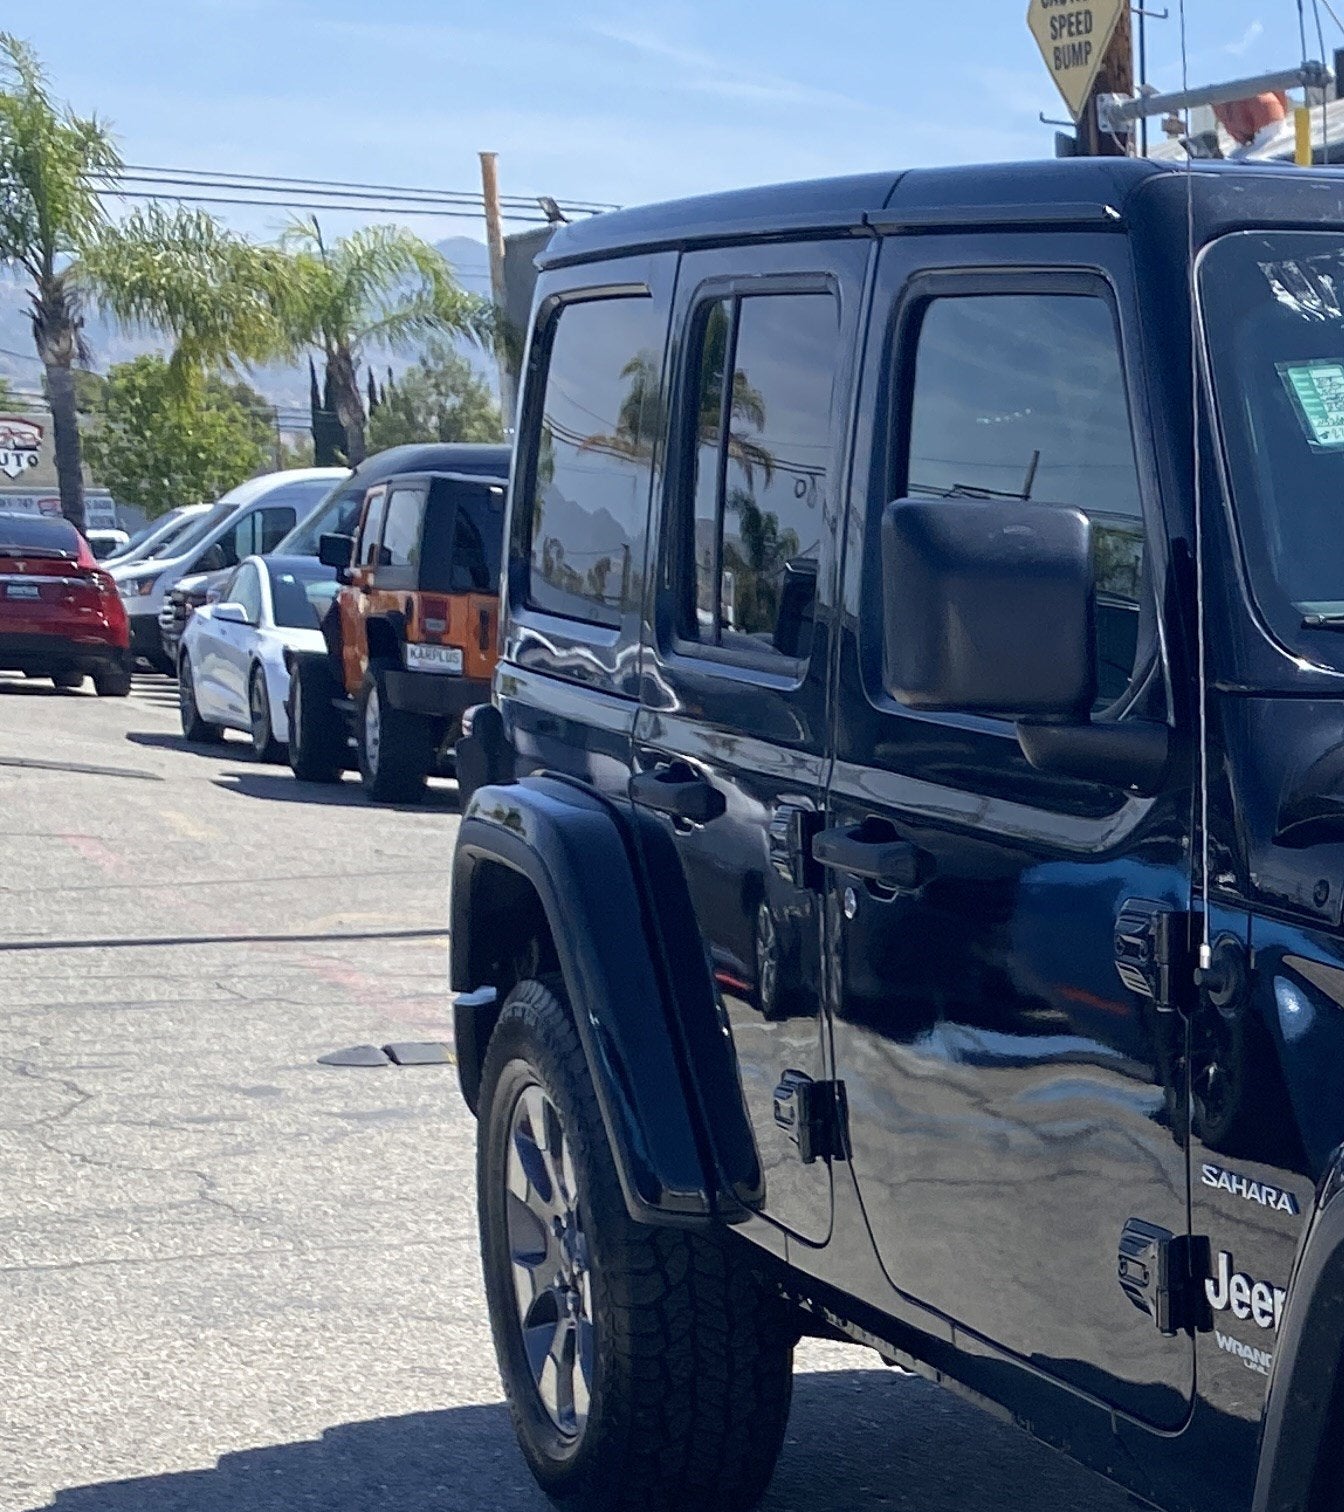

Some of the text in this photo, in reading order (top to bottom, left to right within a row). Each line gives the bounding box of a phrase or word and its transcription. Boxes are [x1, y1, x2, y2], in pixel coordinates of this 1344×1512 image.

[1050, 9, 1093, 40] SPEED
[1054, 41, 1091, 70] BUMP
[1201, 1163, 1301, 1216] SAHARA
